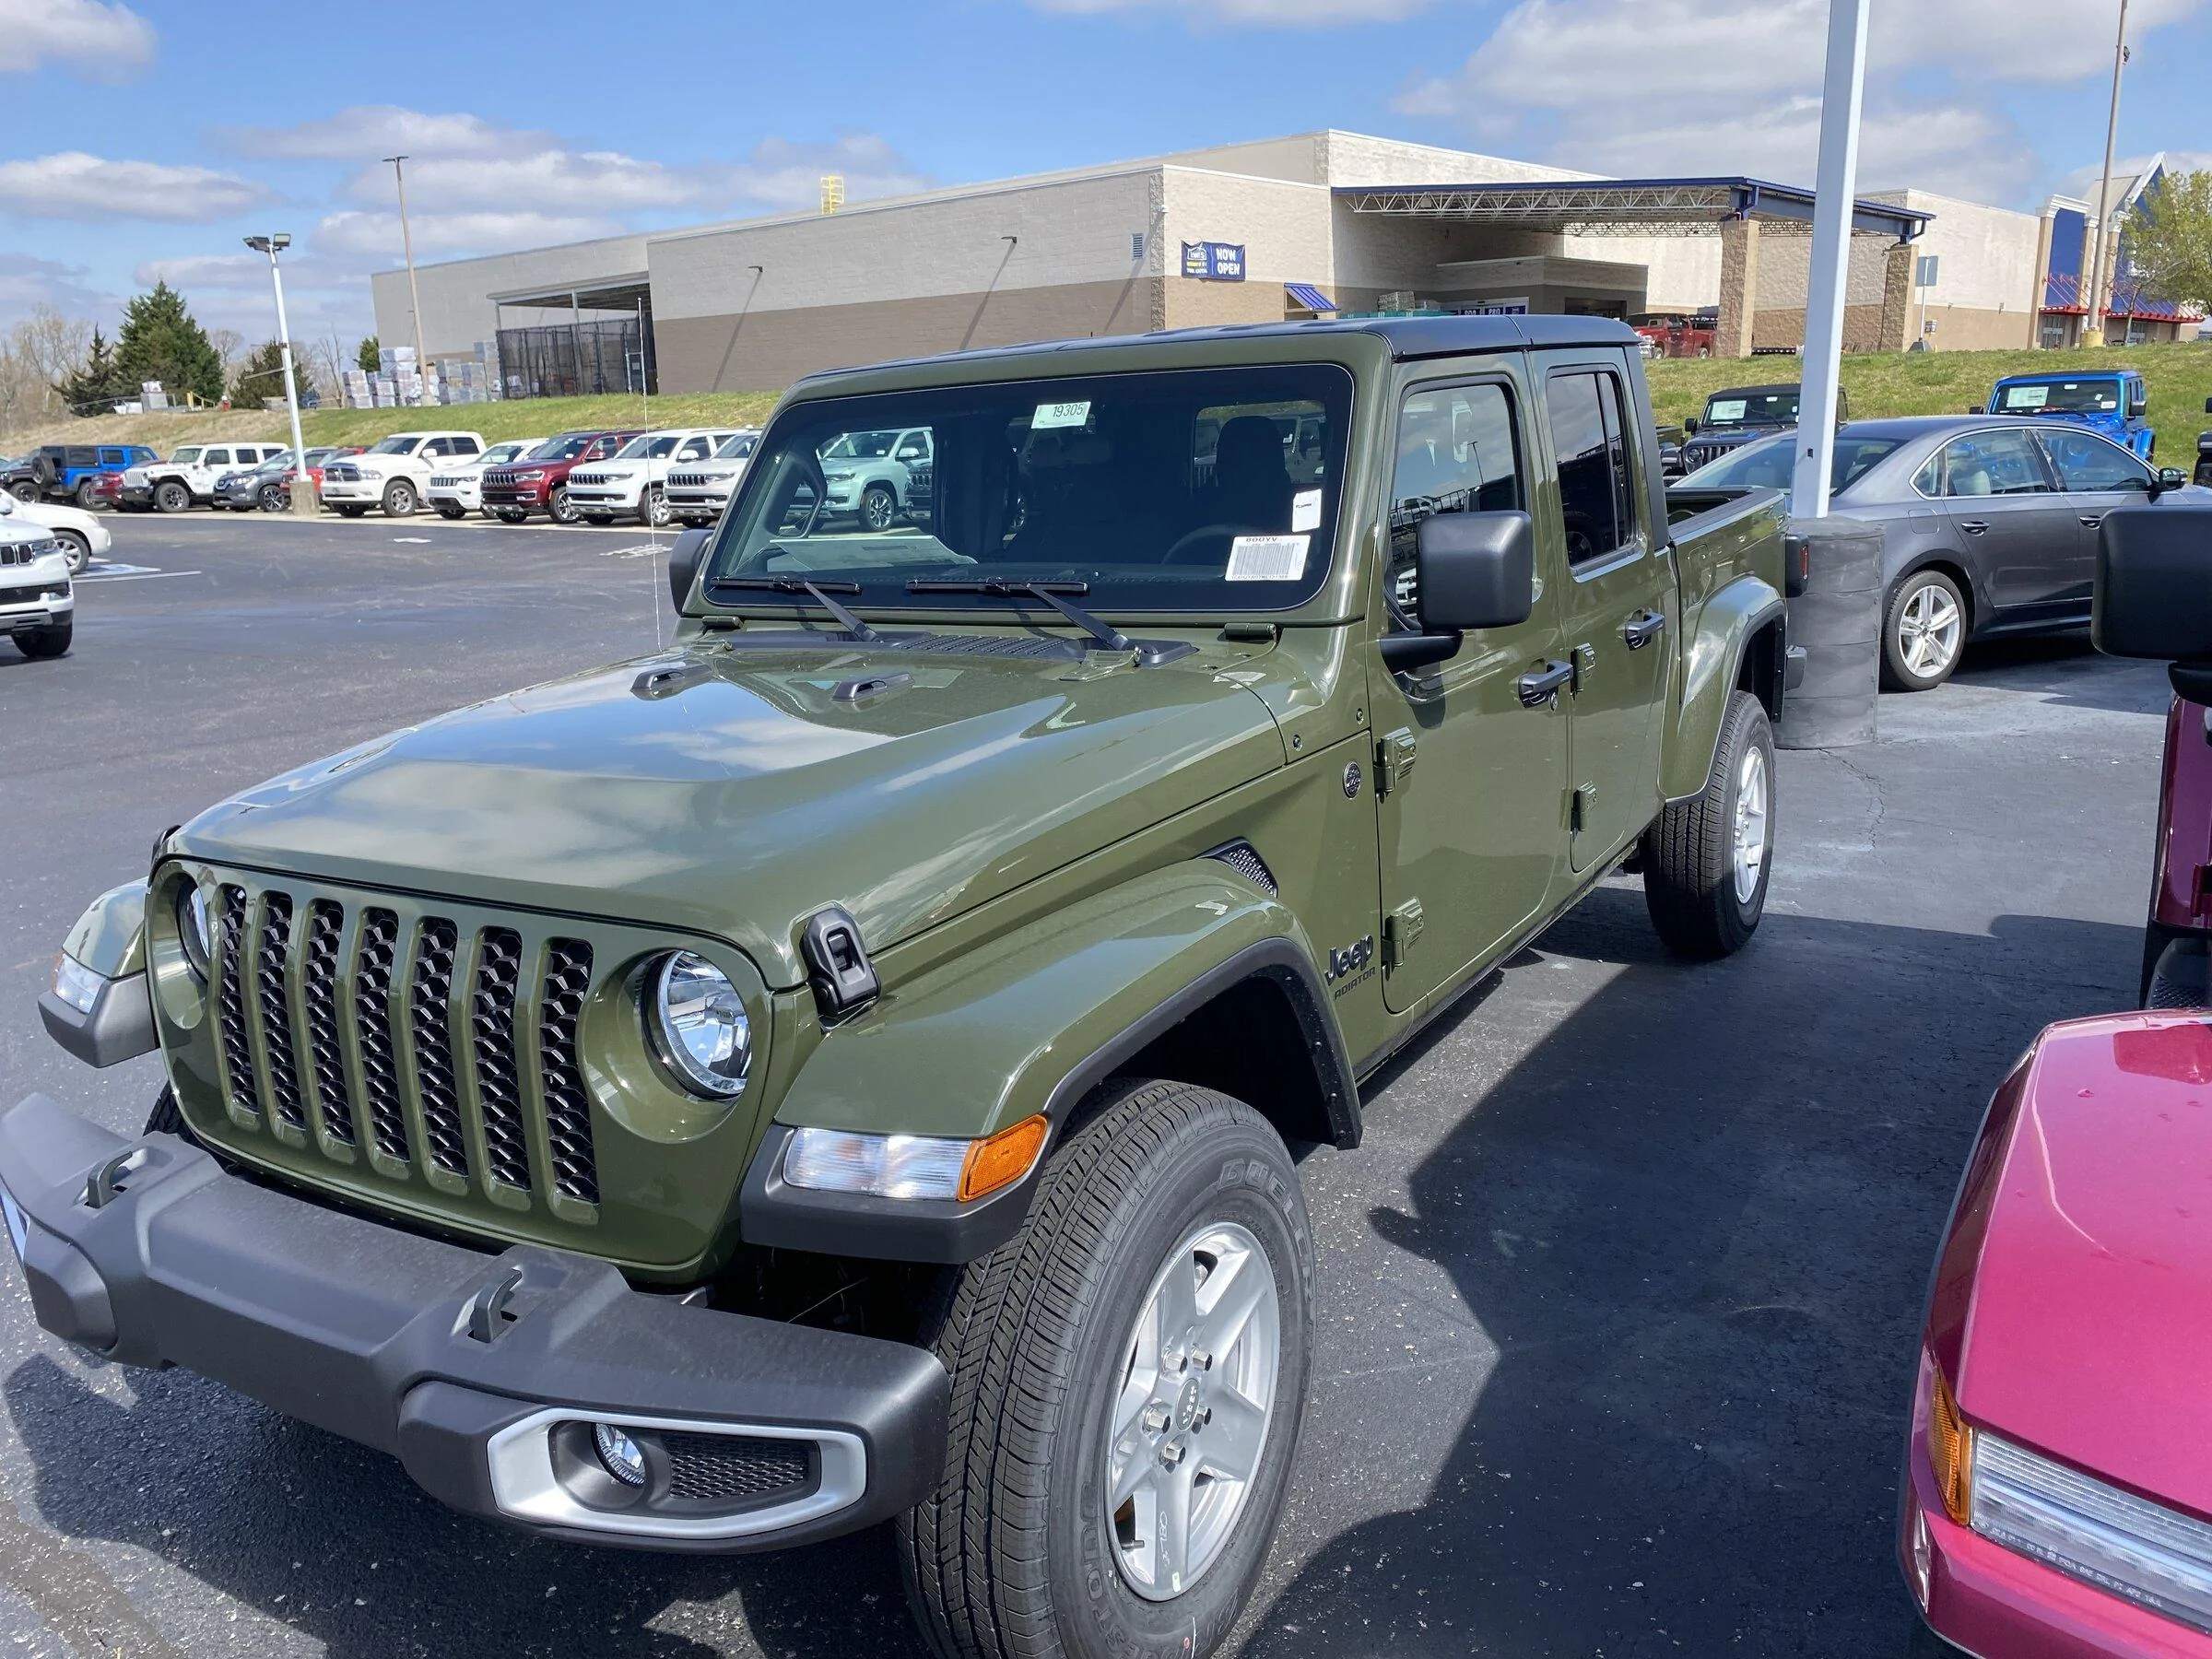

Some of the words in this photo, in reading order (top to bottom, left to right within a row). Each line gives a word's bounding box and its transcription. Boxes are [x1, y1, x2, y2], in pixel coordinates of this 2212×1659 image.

[1216, 248, 1236, 261] NOW
[1217, 262, 1240, 275] OPEN
[1053, 403, 1085, 418] 19305
[1324, 935, 1373, 986] Jeep
[1335, 966, 1376, 1000] ADIATOR
